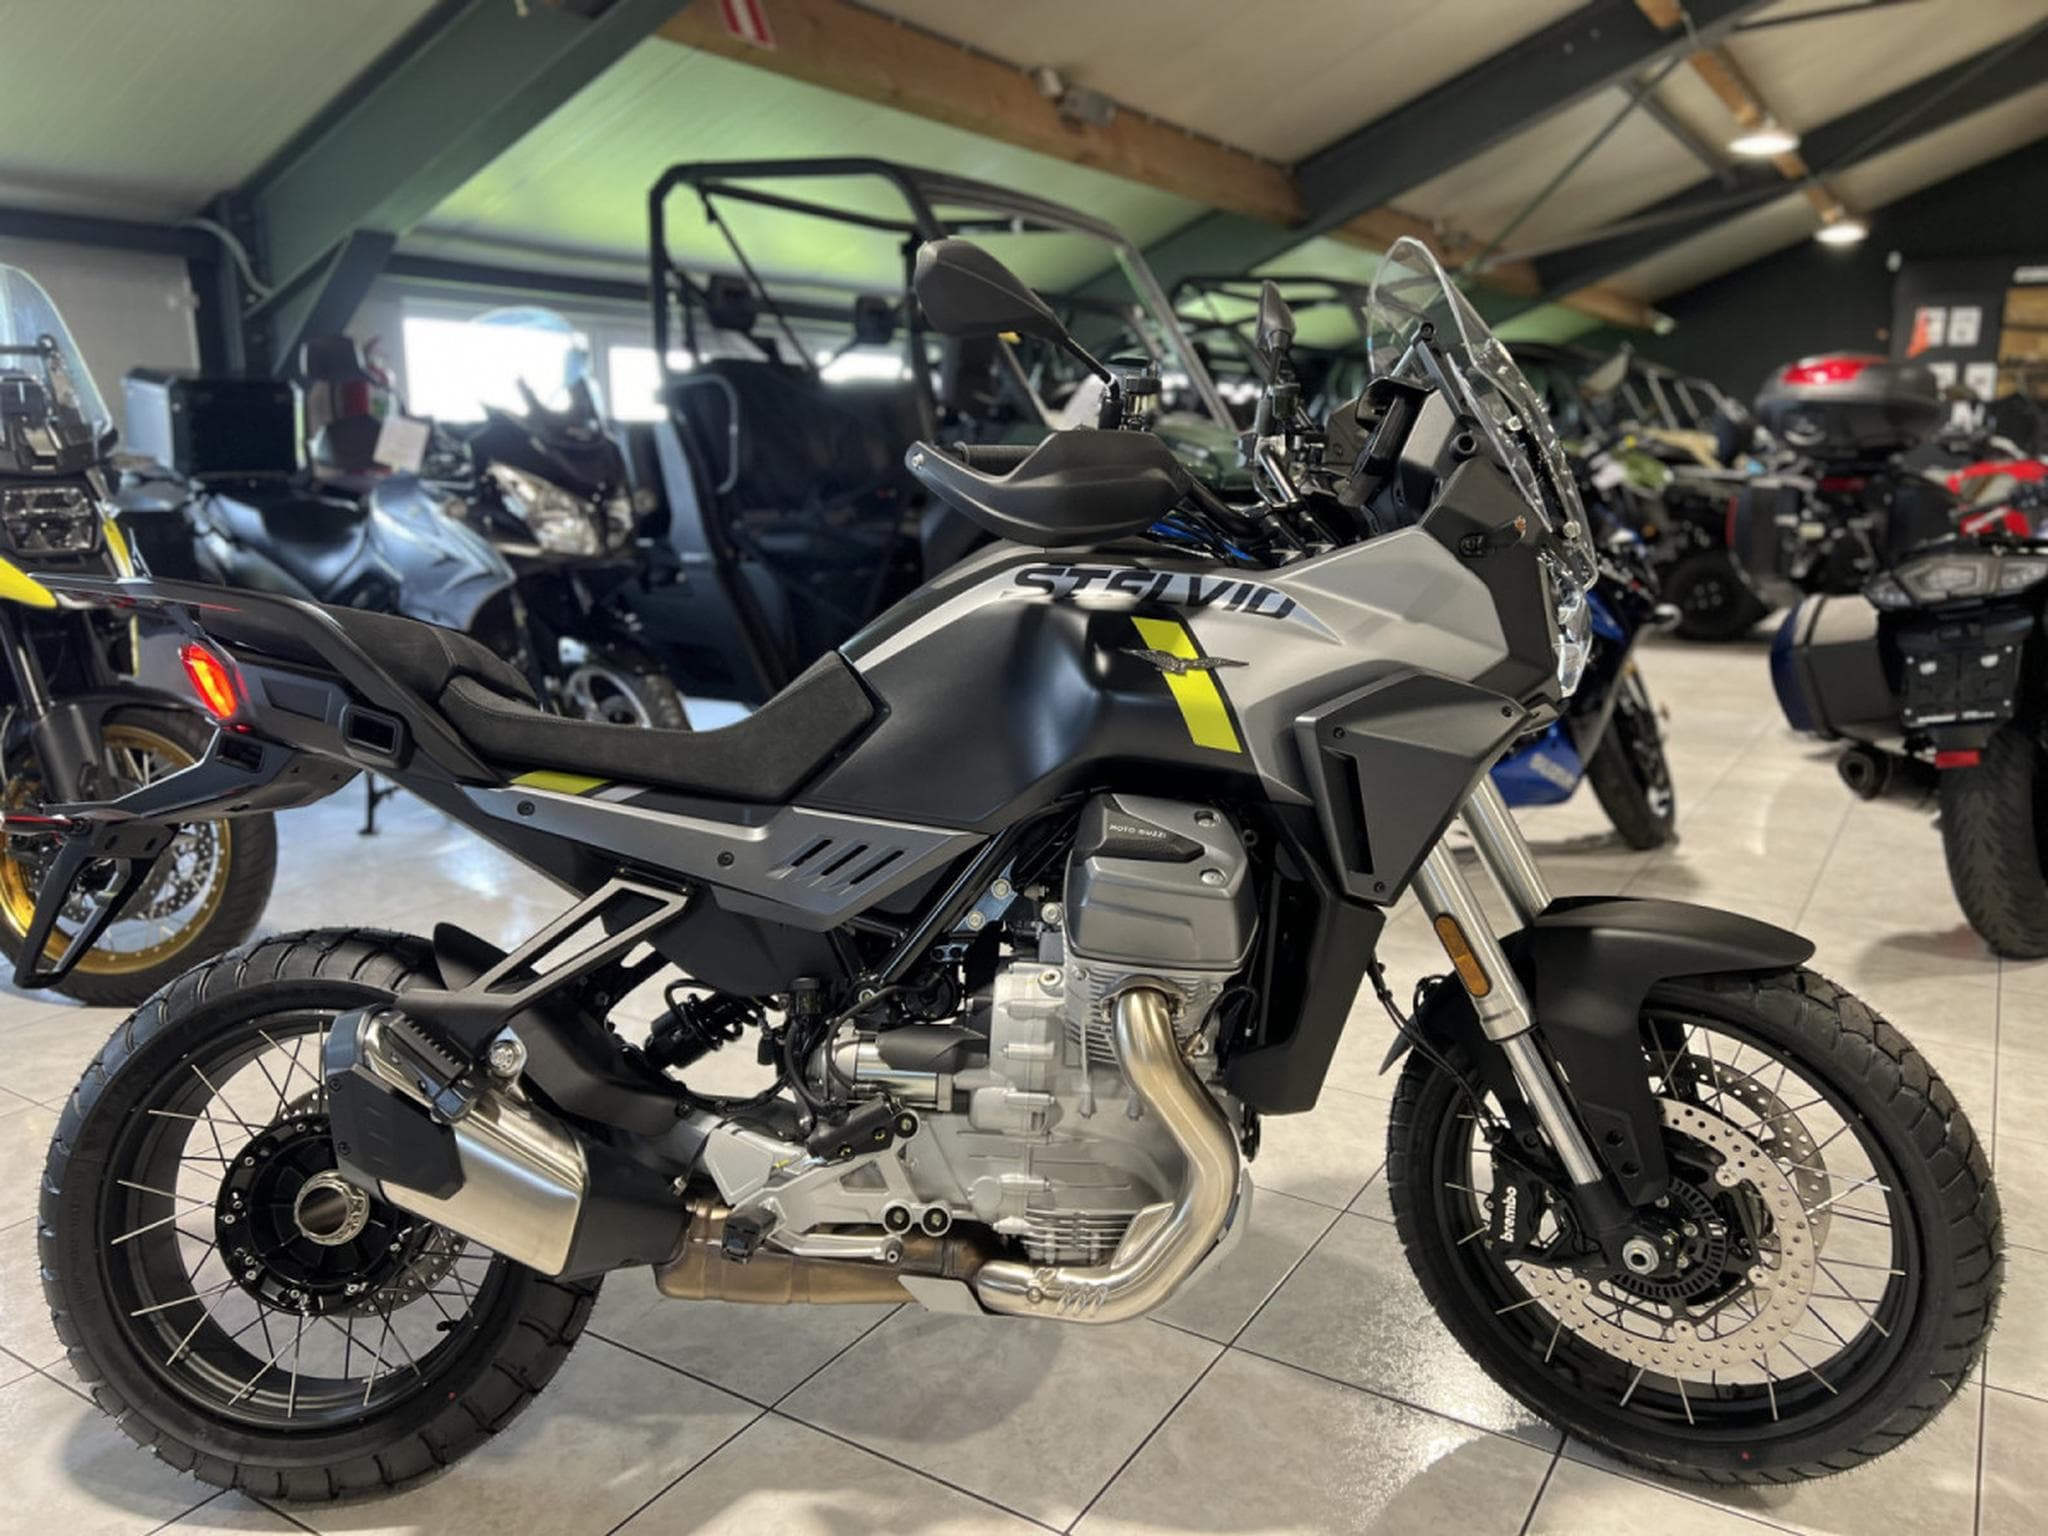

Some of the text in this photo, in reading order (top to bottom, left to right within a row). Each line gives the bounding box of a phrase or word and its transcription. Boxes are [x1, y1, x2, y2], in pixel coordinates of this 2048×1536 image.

[1014, 567, 1297, 619] STELVIO
[1109, 823, 1167, 839] MOTO GUZZI
[1500, 1186, 1518, 1243] brembo
